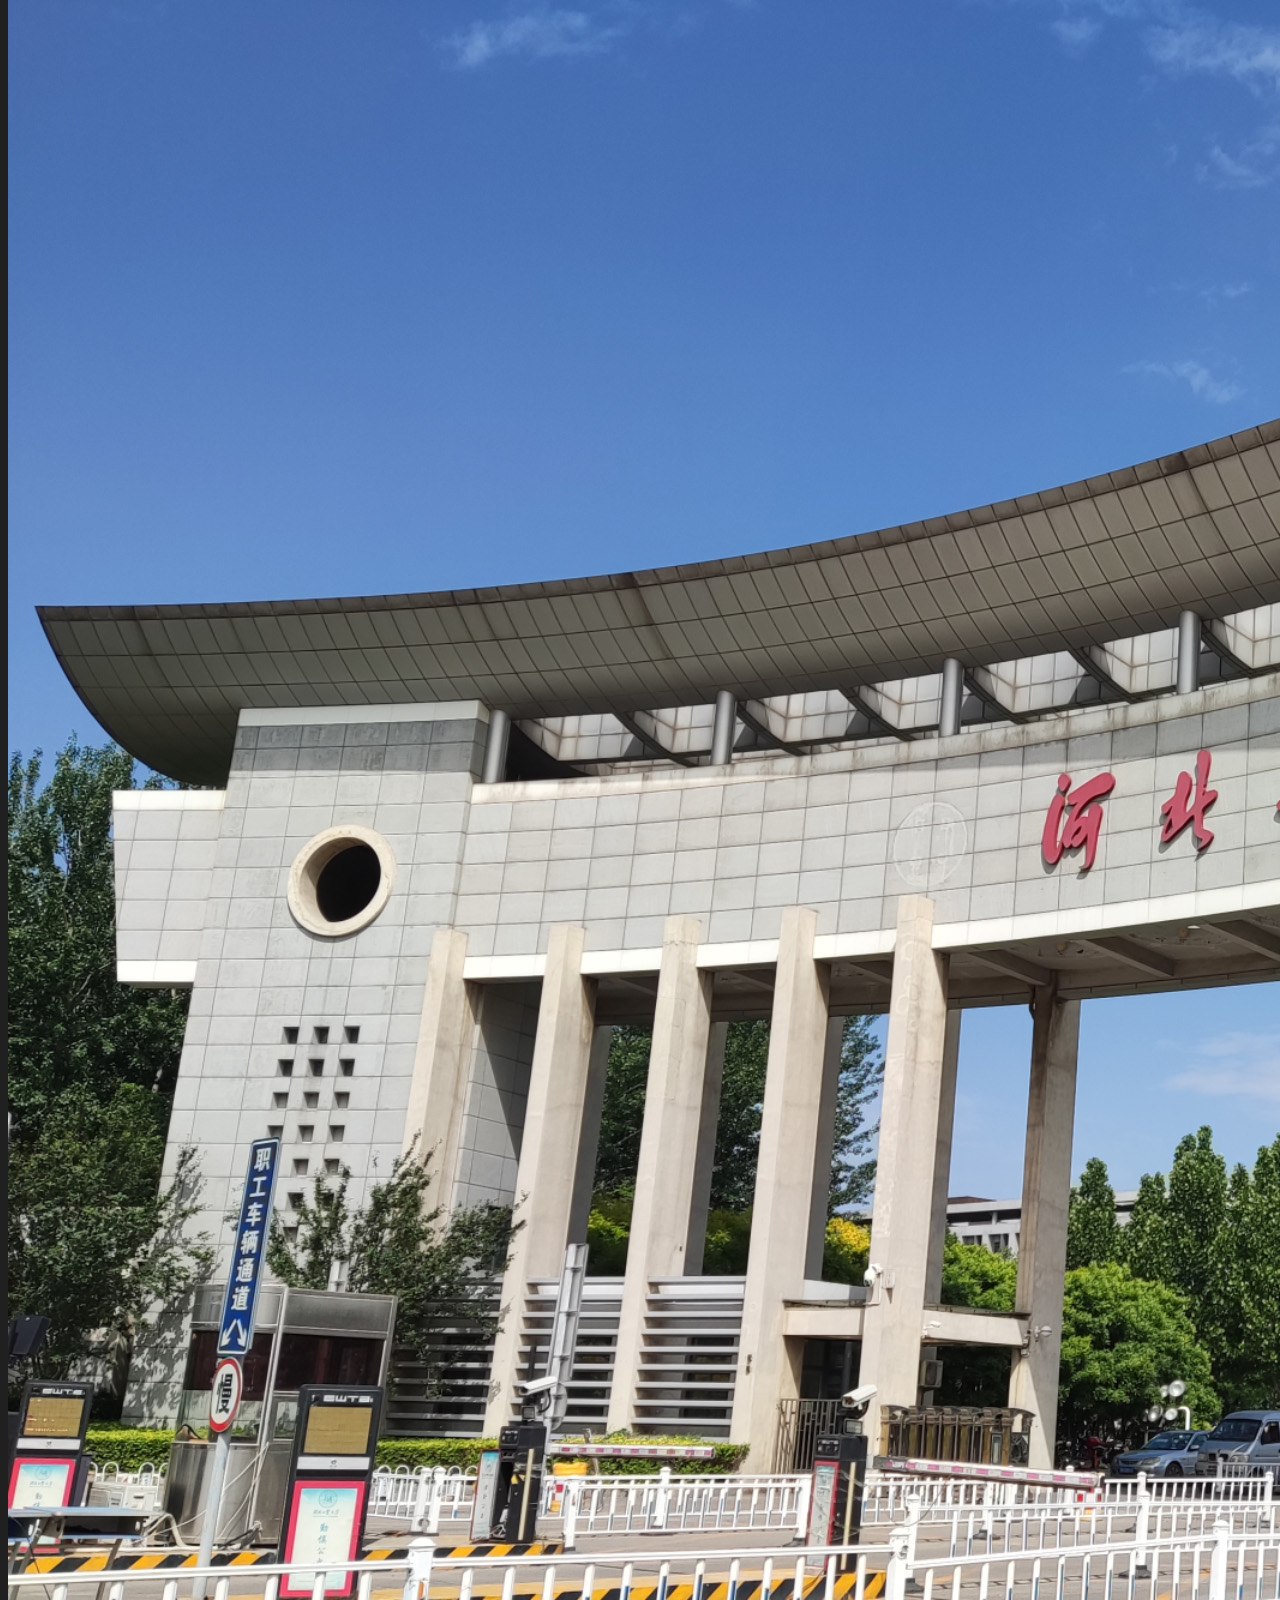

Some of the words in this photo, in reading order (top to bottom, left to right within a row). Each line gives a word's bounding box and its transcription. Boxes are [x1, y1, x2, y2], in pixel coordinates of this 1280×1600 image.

[231, 1147, 272, 1311] 职工车辆通道
[216, 1373, 234, 1414] 慢
